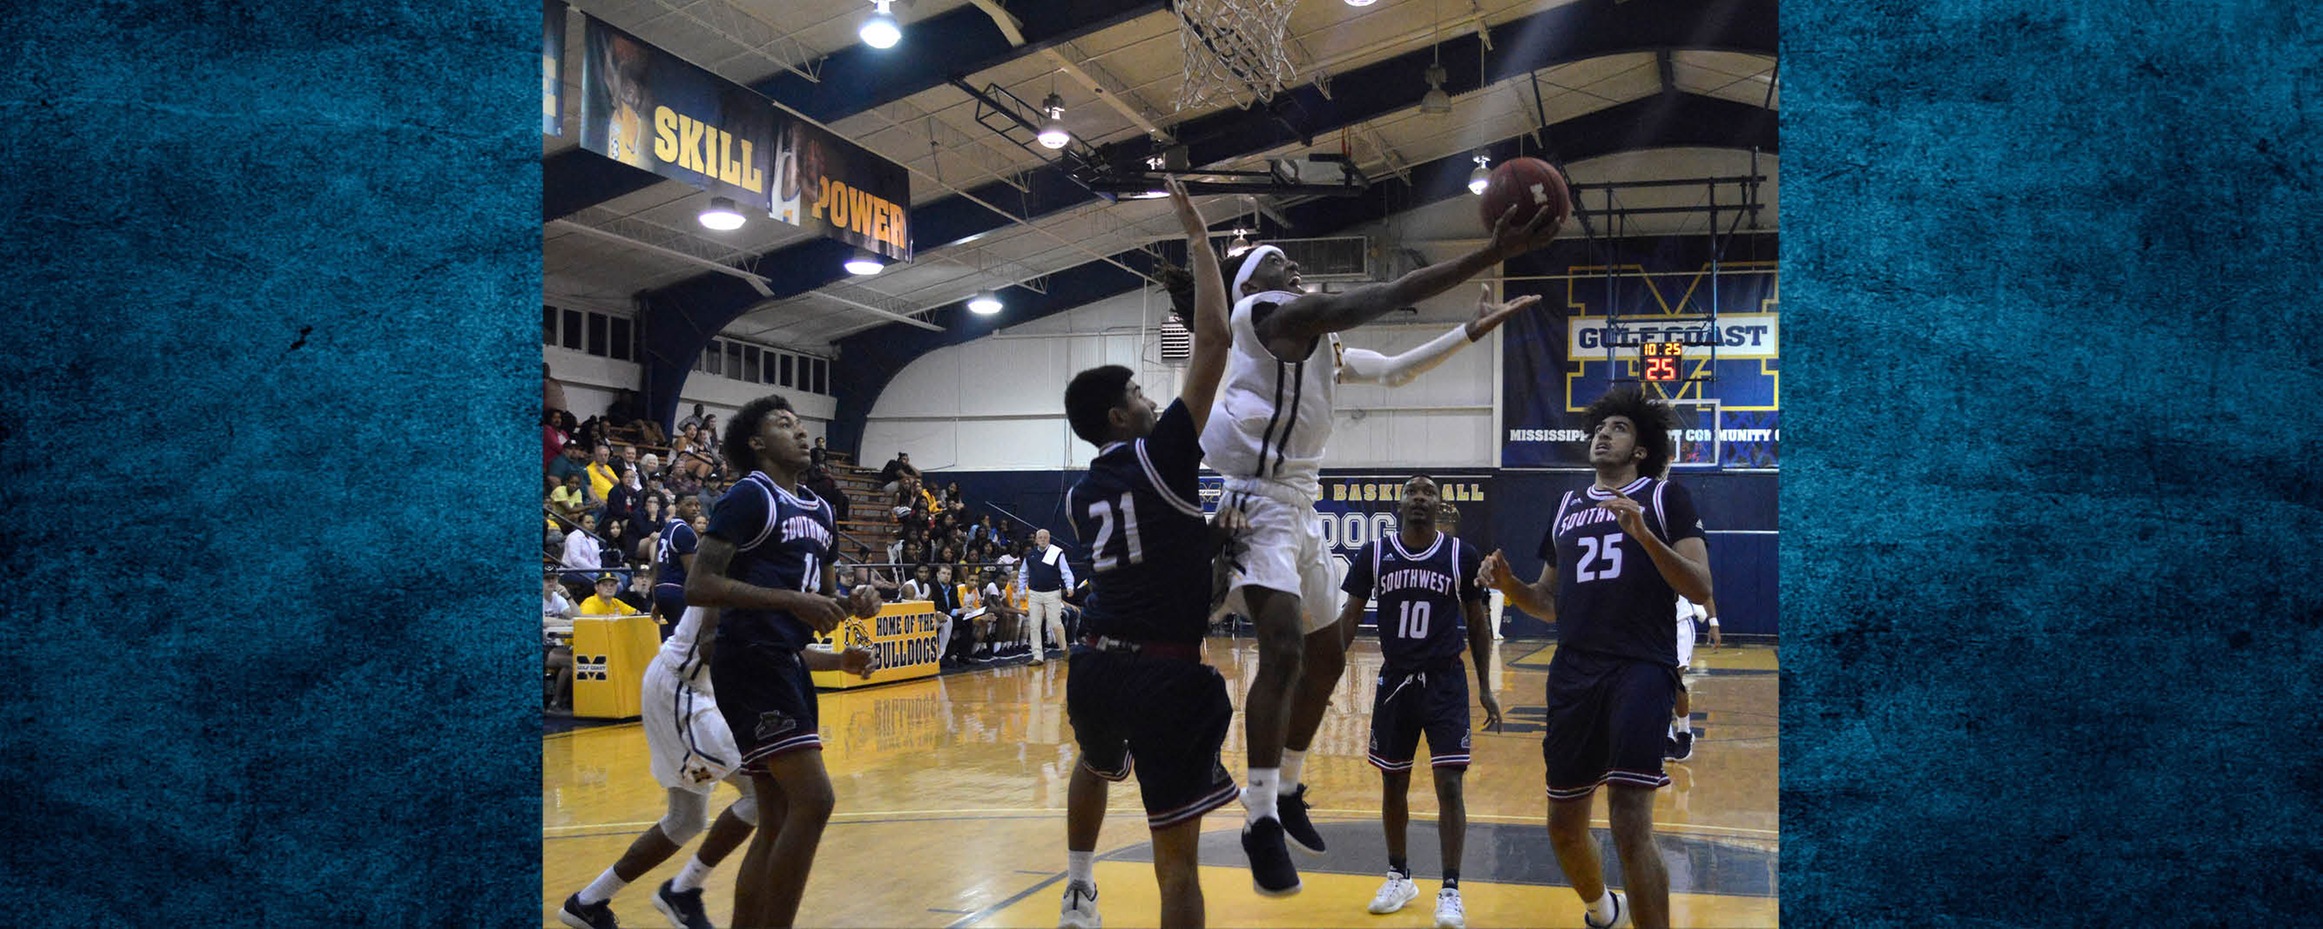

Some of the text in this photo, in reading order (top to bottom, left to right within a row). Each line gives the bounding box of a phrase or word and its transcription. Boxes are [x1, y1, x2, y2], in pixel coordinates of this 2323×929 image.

[655, 105, 762, 194] SKILL
[811, 175, 905, 250] POWER
[1646, 358, 1676, 380] 25
[1334, 484, 1484, 501] BASKALL
[1089, 491, 1144, 573] 21
[1577, 533, 1623, 583] 25
[1381, 569, 1452, 596] SOUTHWEST
[876, 613, 935, 636] HOME OF THE
[1398, 601, 1430, 638] 10
[873, 636, 937, 670] BULLDOGS
